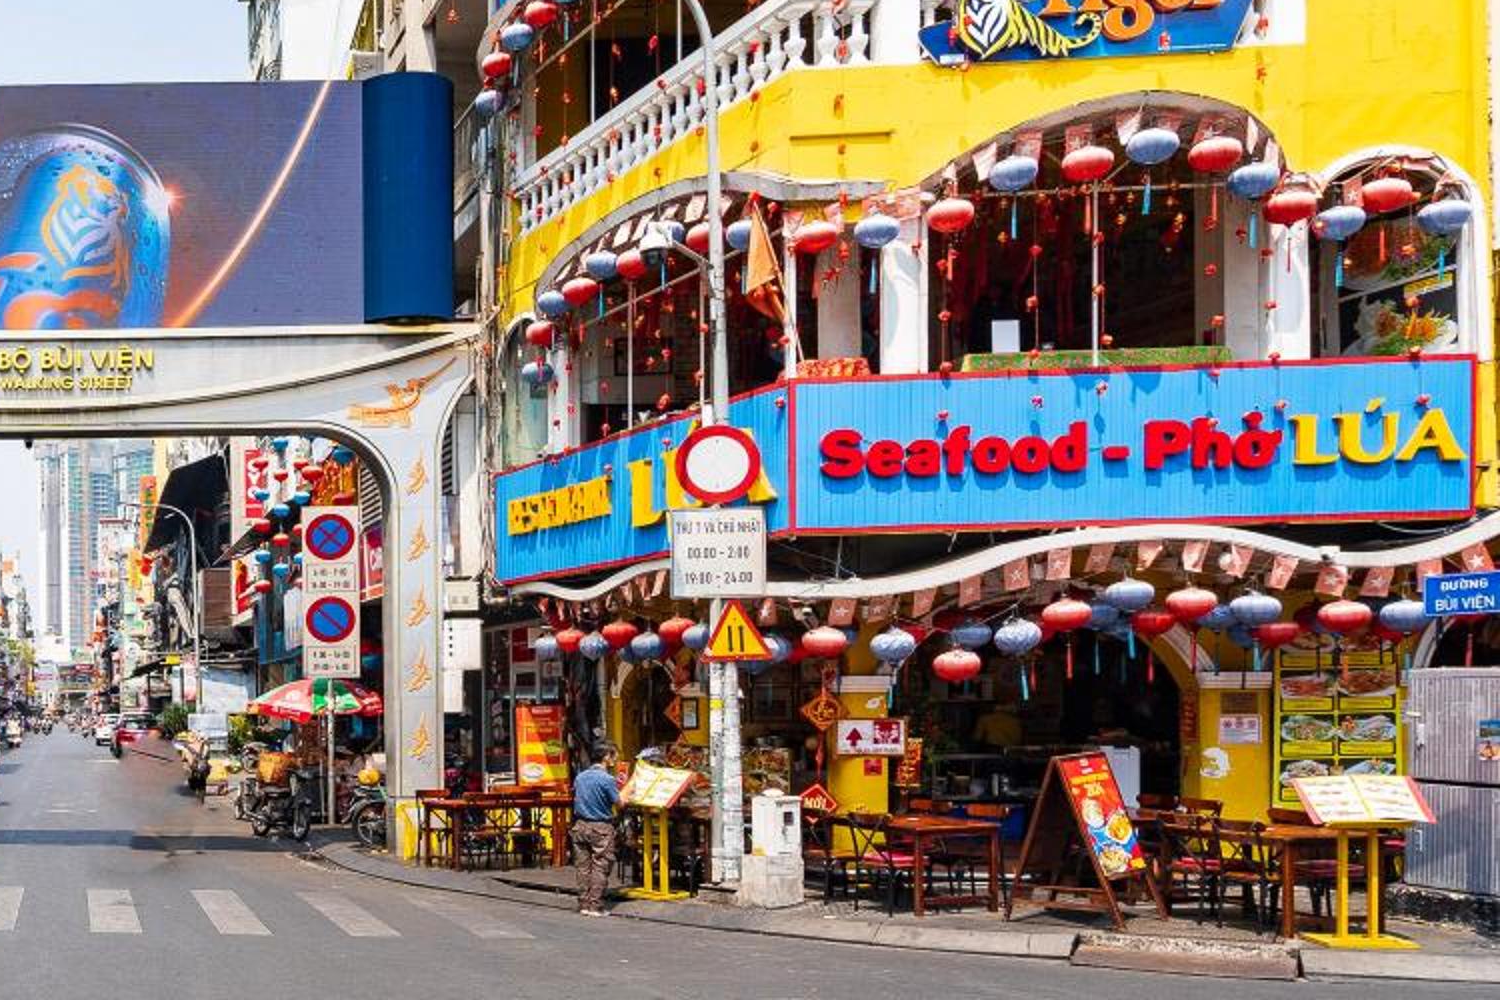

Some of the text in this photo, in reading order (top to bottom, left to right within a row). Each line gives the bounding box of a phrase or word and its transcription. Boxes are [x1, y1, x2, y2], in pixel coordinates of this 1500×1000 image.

[0, 346, 32, 374] BỘ
[41, 344, 82, 371] BÙI
[90, 346, 155, 374] VIỆN
[0, 375, 74, 391] WALKING
[78, 374, 134, 391] STREET
[820, 421, 1089, 478] Seafood
[1144, 411, 1283, 470] Phở
[1288, 397, 1468, 465] LÚA
[1435, 594, 1459, 612] BÙI
